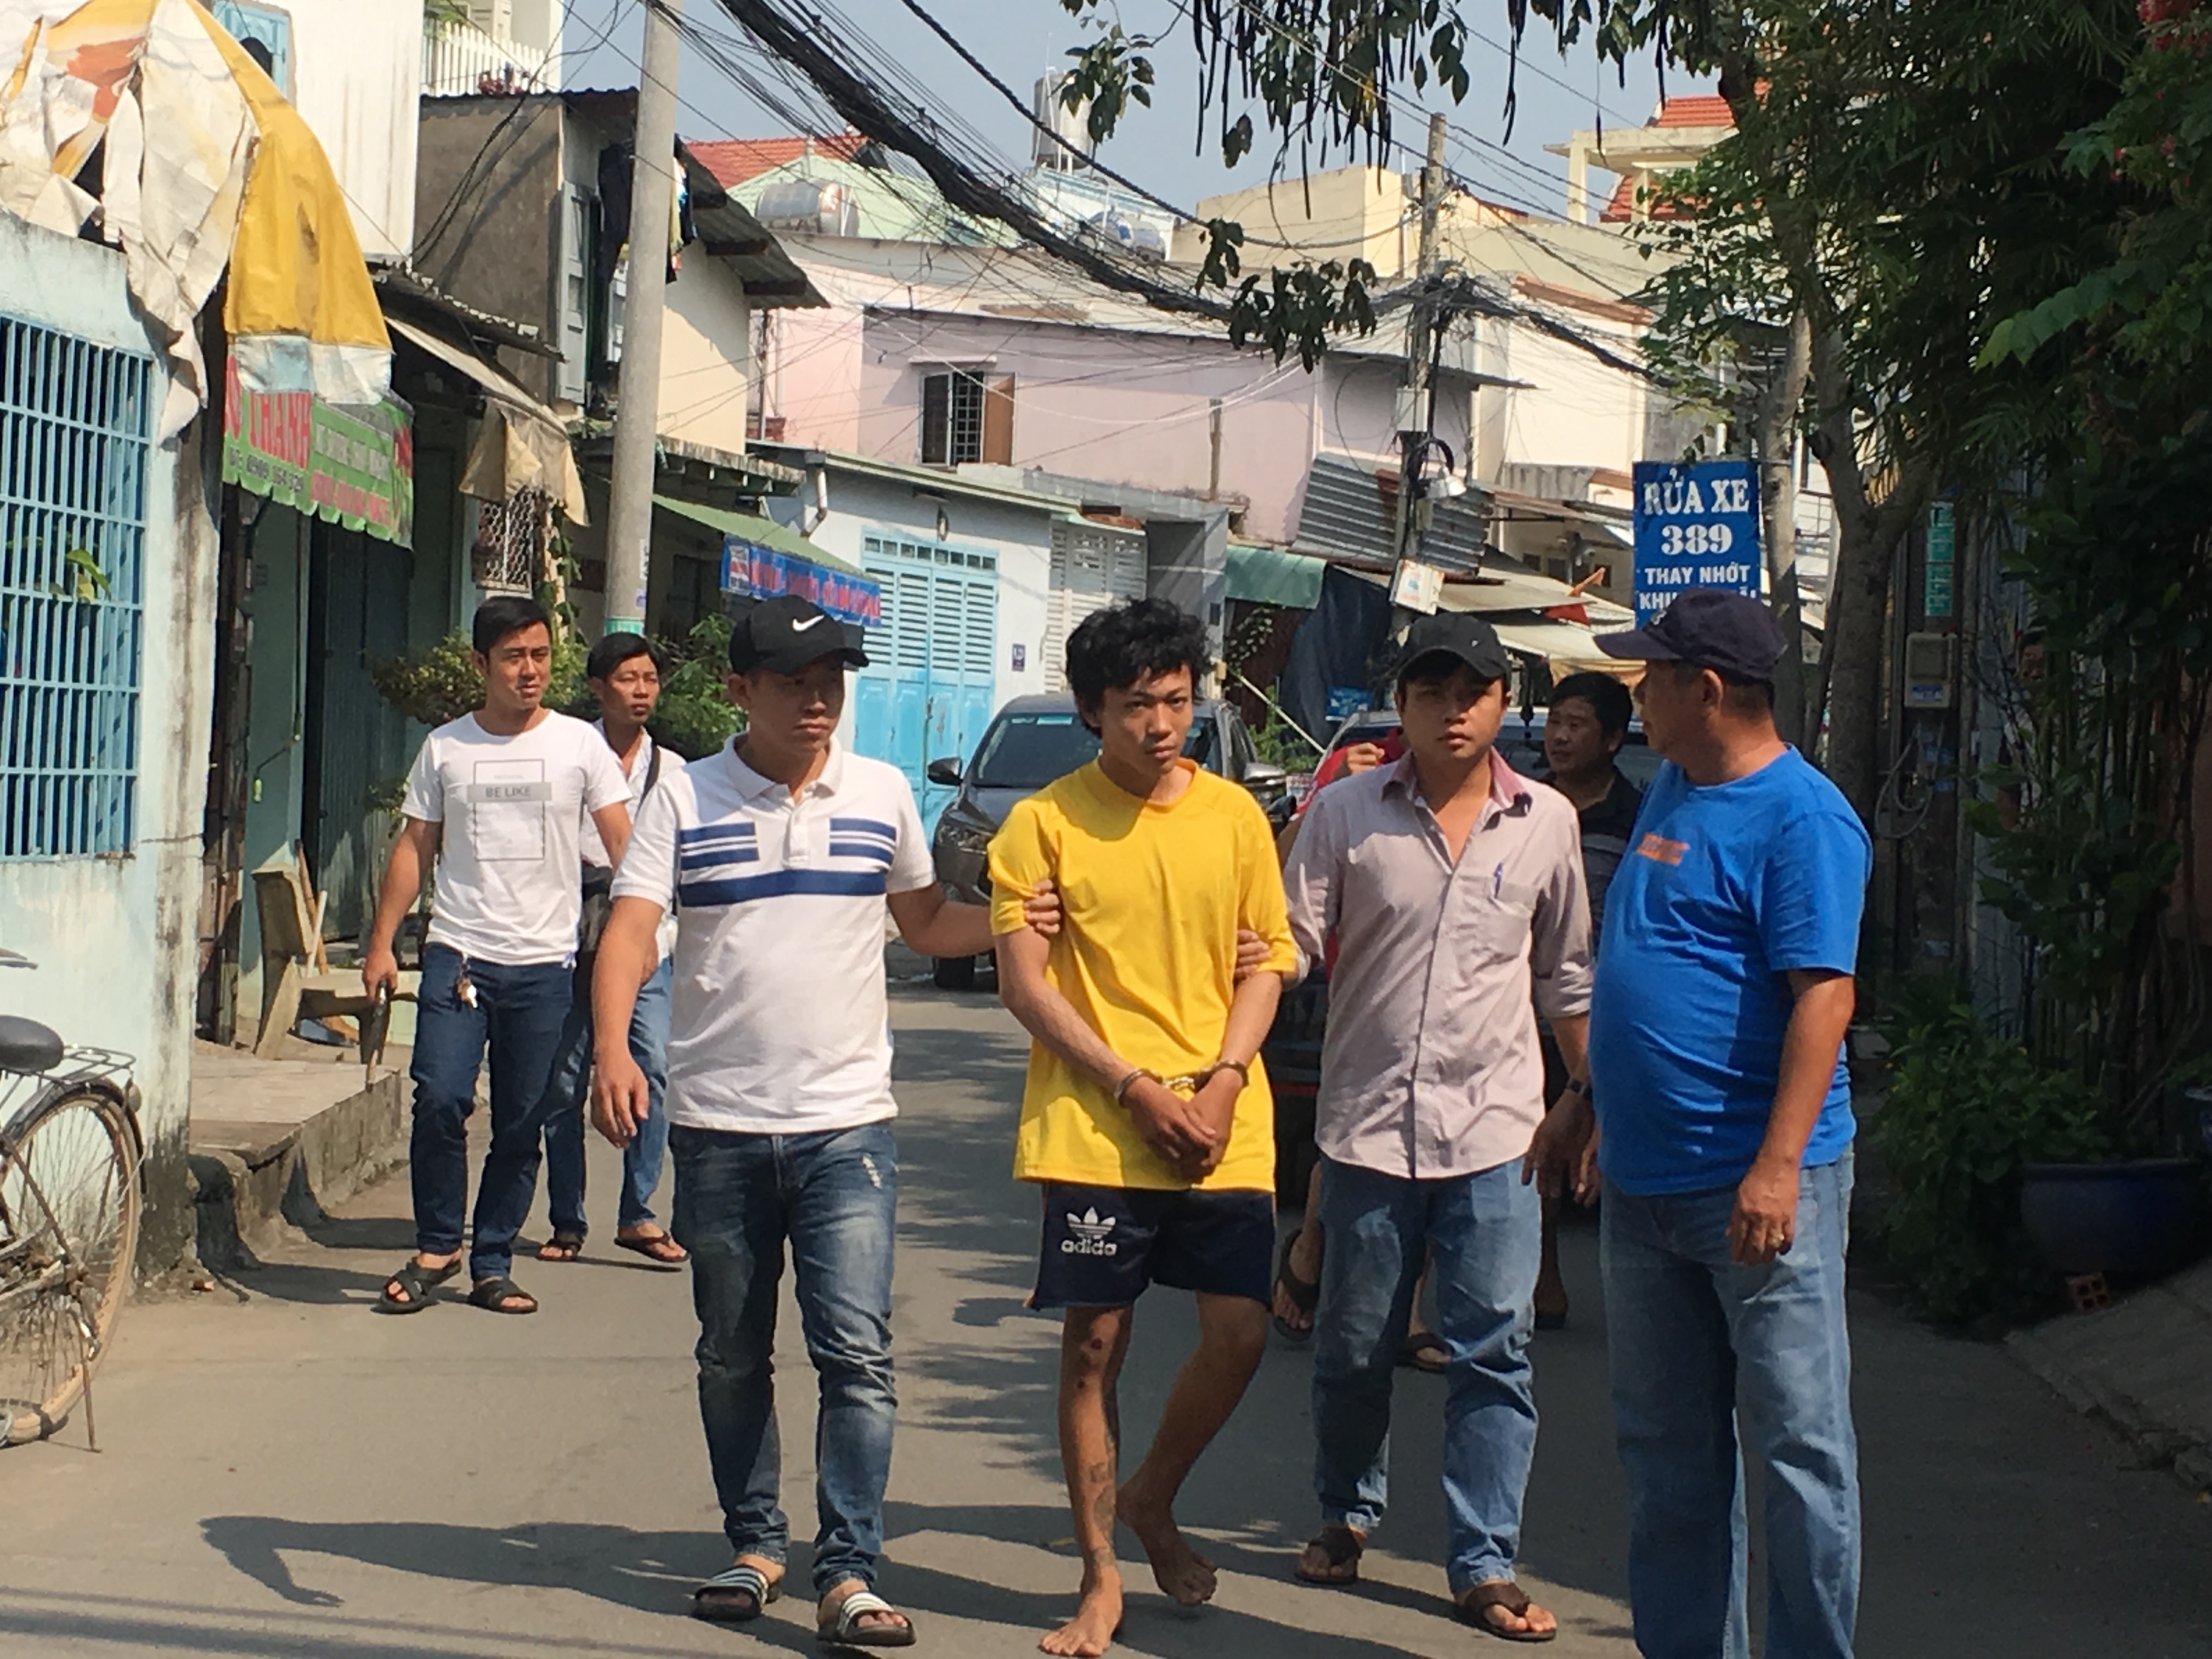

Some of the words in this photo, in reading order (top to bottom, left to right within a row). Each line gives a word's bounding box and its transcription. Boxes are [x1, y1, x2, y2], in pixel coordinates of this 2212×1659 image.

[1643, 467, 1705, 516] RỬA
[1711, 479, 1750, 513] XE
[1661, 523, 1733, 555] 389
[1644, 567, 1694, 585] THAY
[1699, 561, 1751, 583] NHỚT
[486, 787, 501, 798] BE
[505, 786, 531, 797] LIKE
